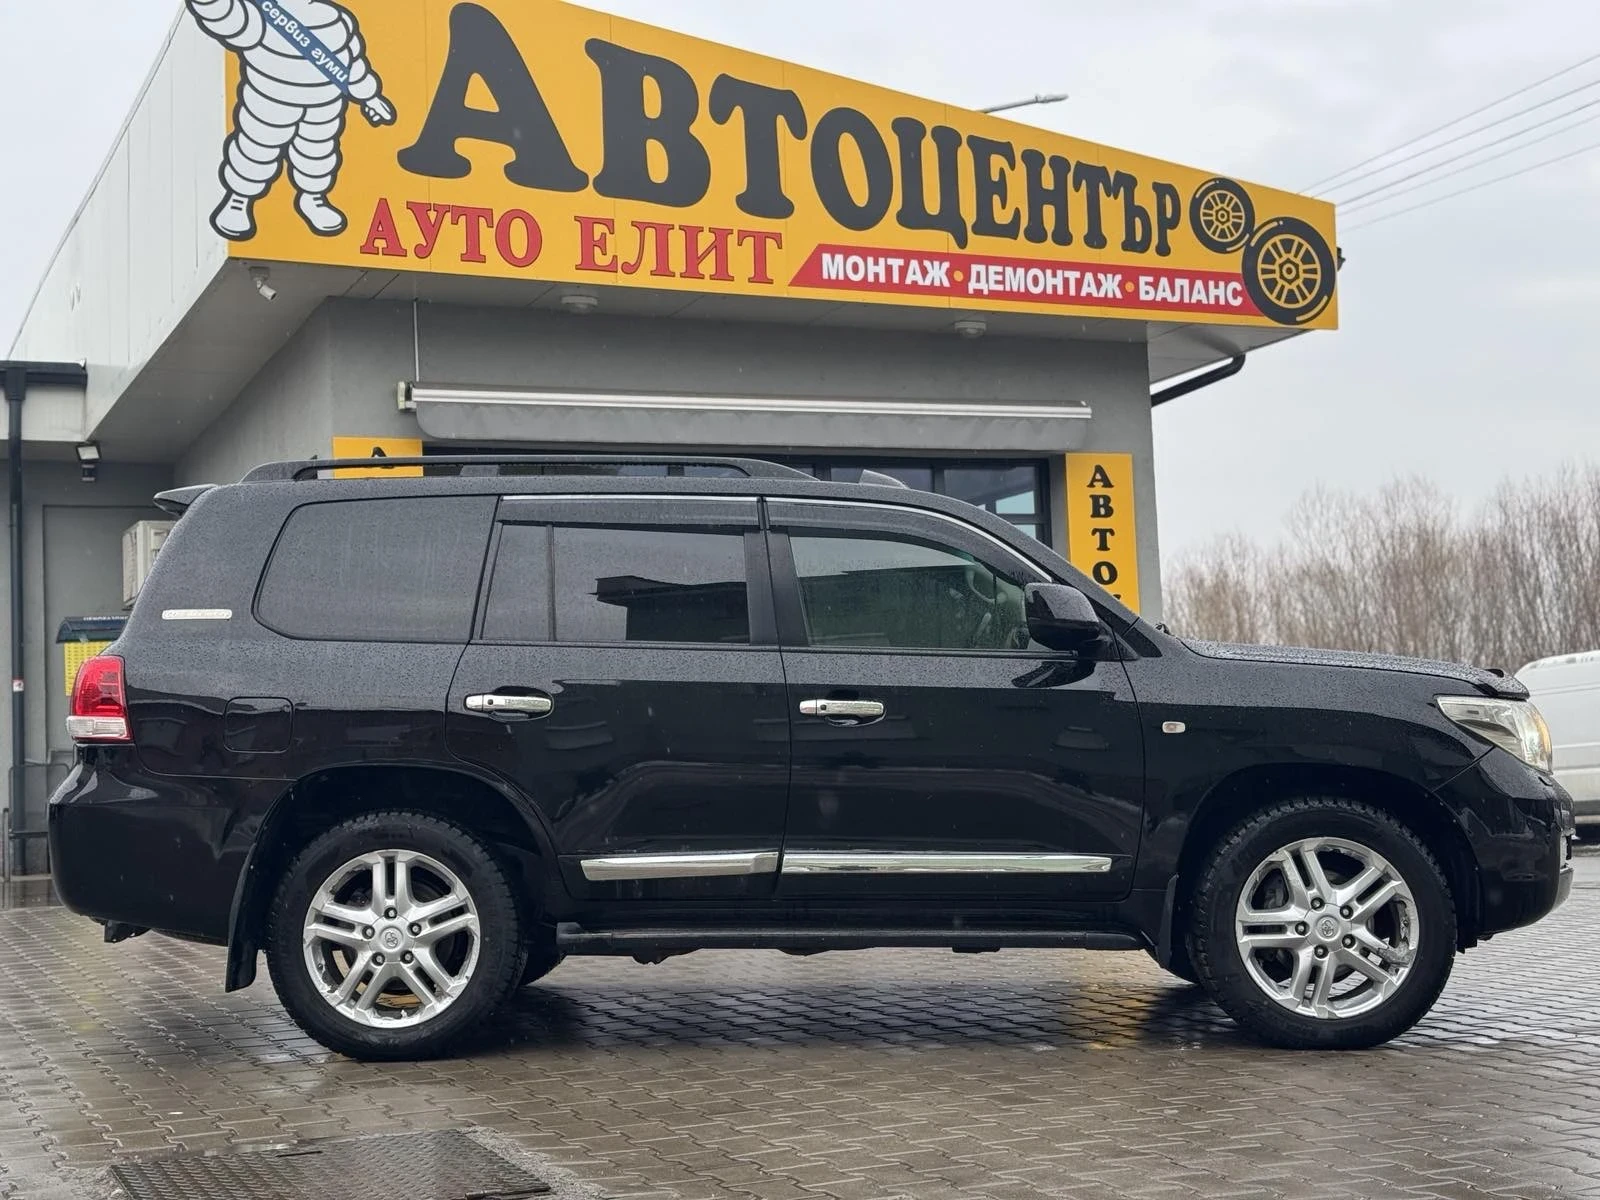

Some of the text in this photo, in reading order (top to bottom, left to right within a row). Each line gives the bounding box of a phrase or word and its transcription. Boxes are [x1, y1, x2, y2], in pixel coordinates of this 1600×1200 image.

[262, 1, 348, 82] сервиз гуми
[397, 2, 1182, 257] АВТОЦЕНТЪР
[360, 197, 783, 284] АУТО ЕЛИТ
[820, 252, 1244, 307] МОНТАЖ ДЕМОНТАЖ БАЛАНС
[1086, 464, 1122, 600] АВТО
